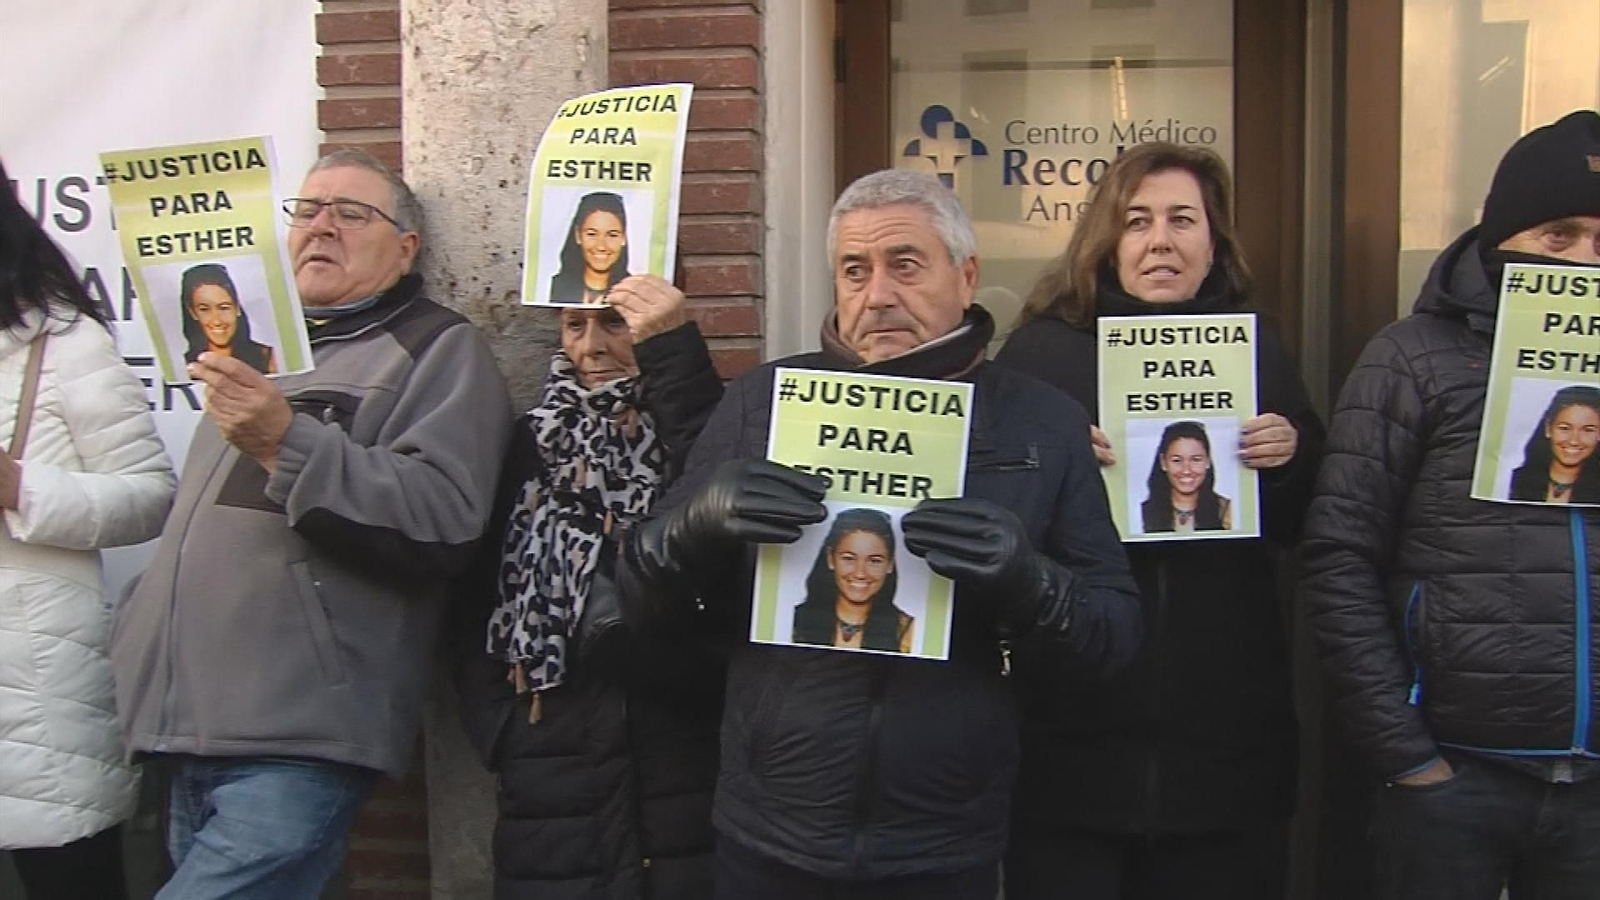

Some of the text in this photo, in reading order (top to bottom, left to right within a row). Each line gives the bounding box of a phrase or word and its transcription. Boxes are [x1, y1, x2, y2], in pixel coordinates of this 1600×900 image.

[569, 127, 637, 145] PARA
[1005, 119, 1217, 145] Centro Médico
[103, 148, 267, 184] #JUSTICIA
[547, 160, 652, 182] ESTHER
[1003, 146, 1125, 185] Reco
[150, 190, 233, 217] PARA
[137, 226, 255, 257] ESTHER
[1107, 326, 1249, 346] #JUSTICIA
[1143, 360, 1215, 378] PARA
[1518, 349, 1600, 373] ESTH
[779, 378, 964, 417] #JUSTICIA
[1126, 392, 1233, 411] ESTHER
[818, 425, 913, 455] PARA
[793, 465, 932, 499] STHER
